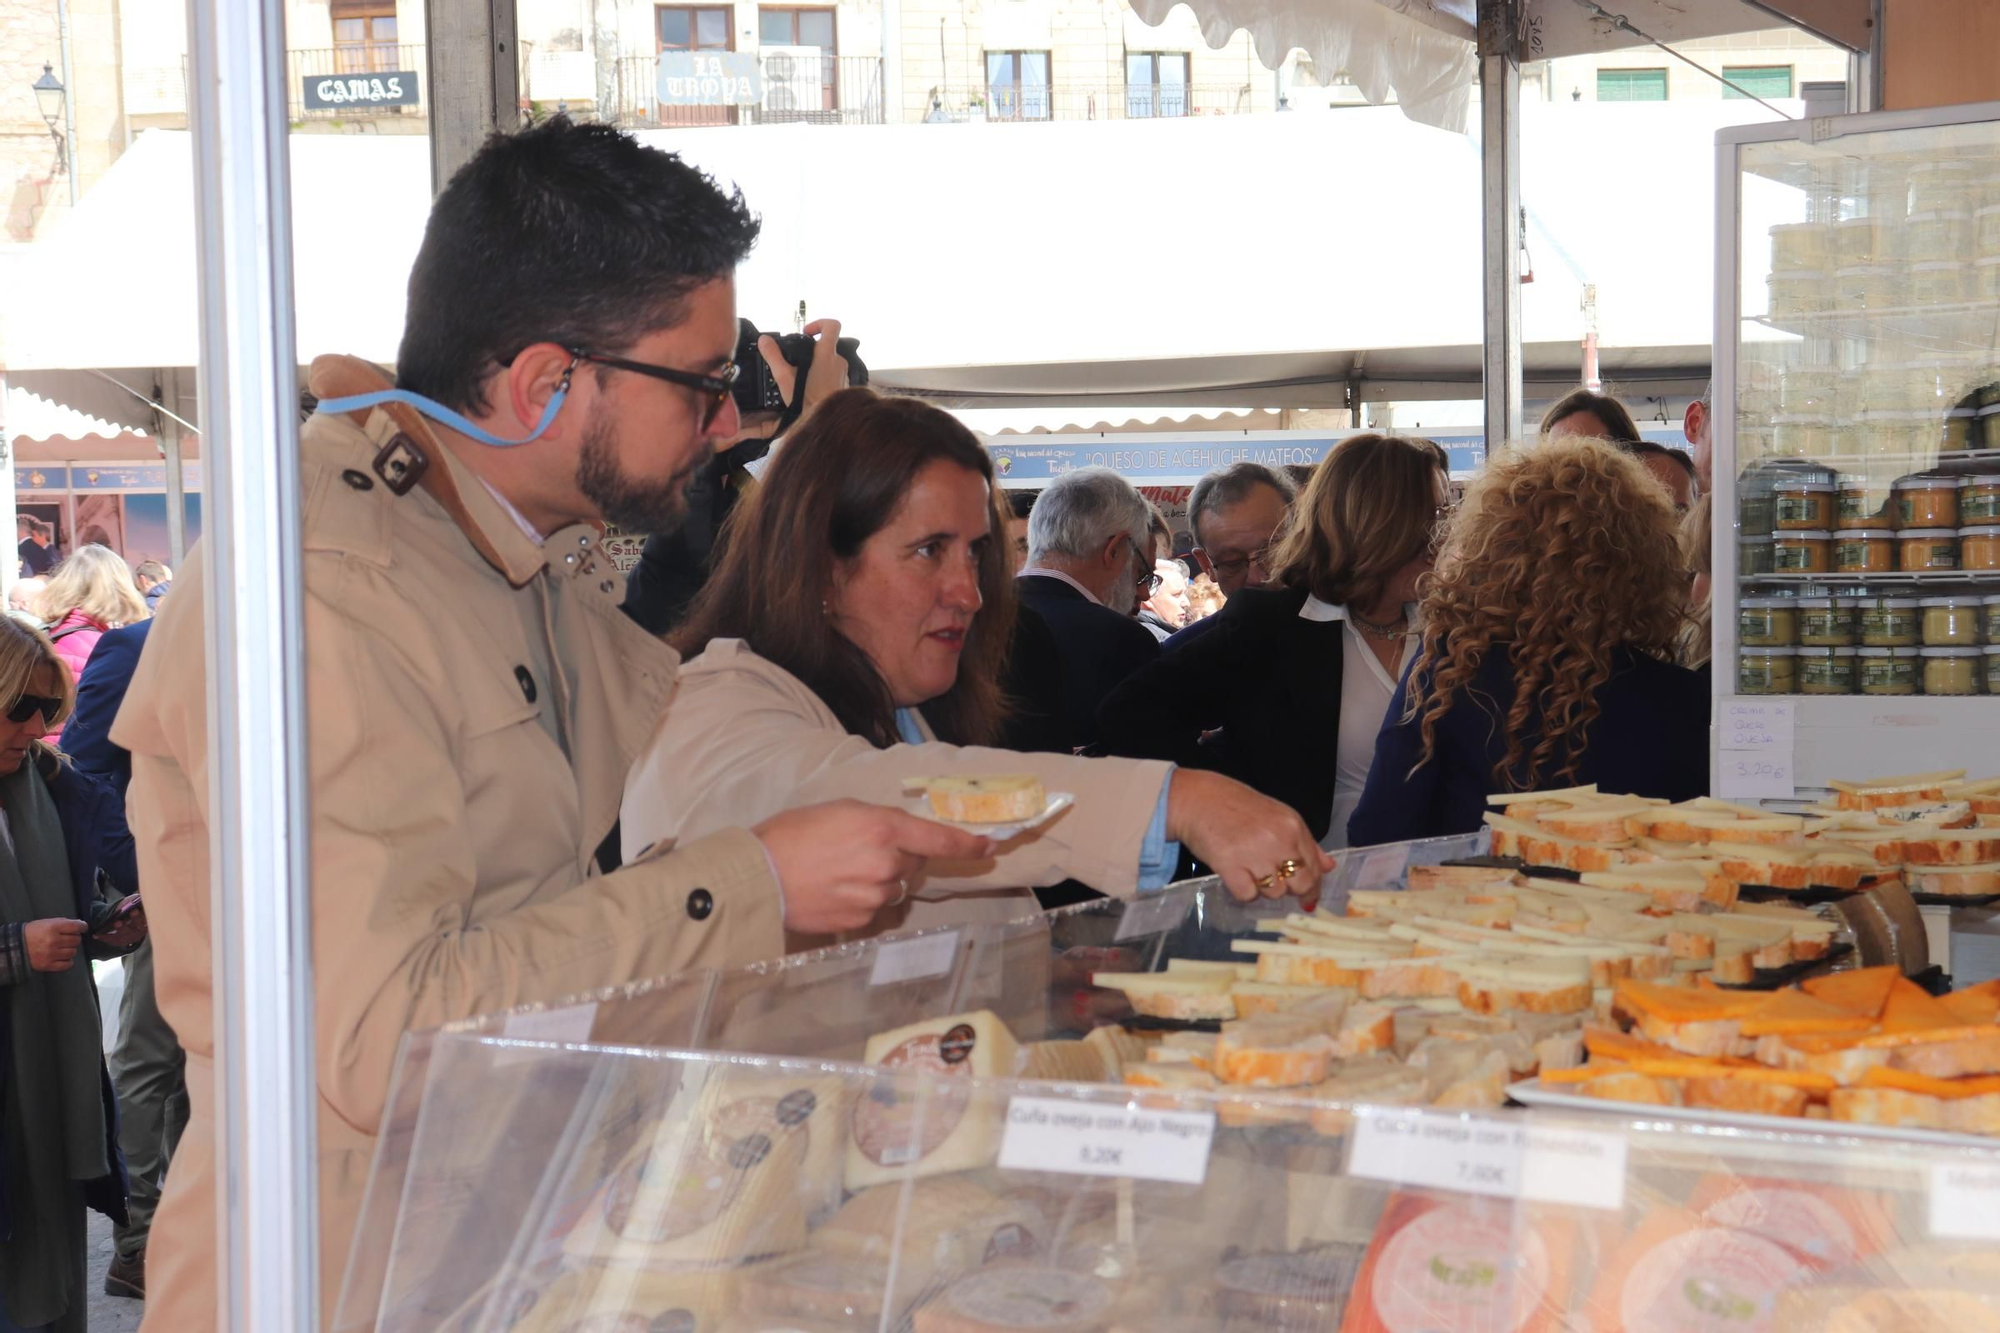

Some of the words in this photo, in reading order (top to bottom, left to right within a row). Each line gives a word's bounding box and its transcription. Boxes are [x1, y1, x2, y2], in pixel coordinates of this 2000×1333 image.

[693, 56, 724, 77] LA
[316, 77, 404, 104] CAMAS
[666, 76, 753, 105] TROYA
[1148, 450, 1167, 468] DE
